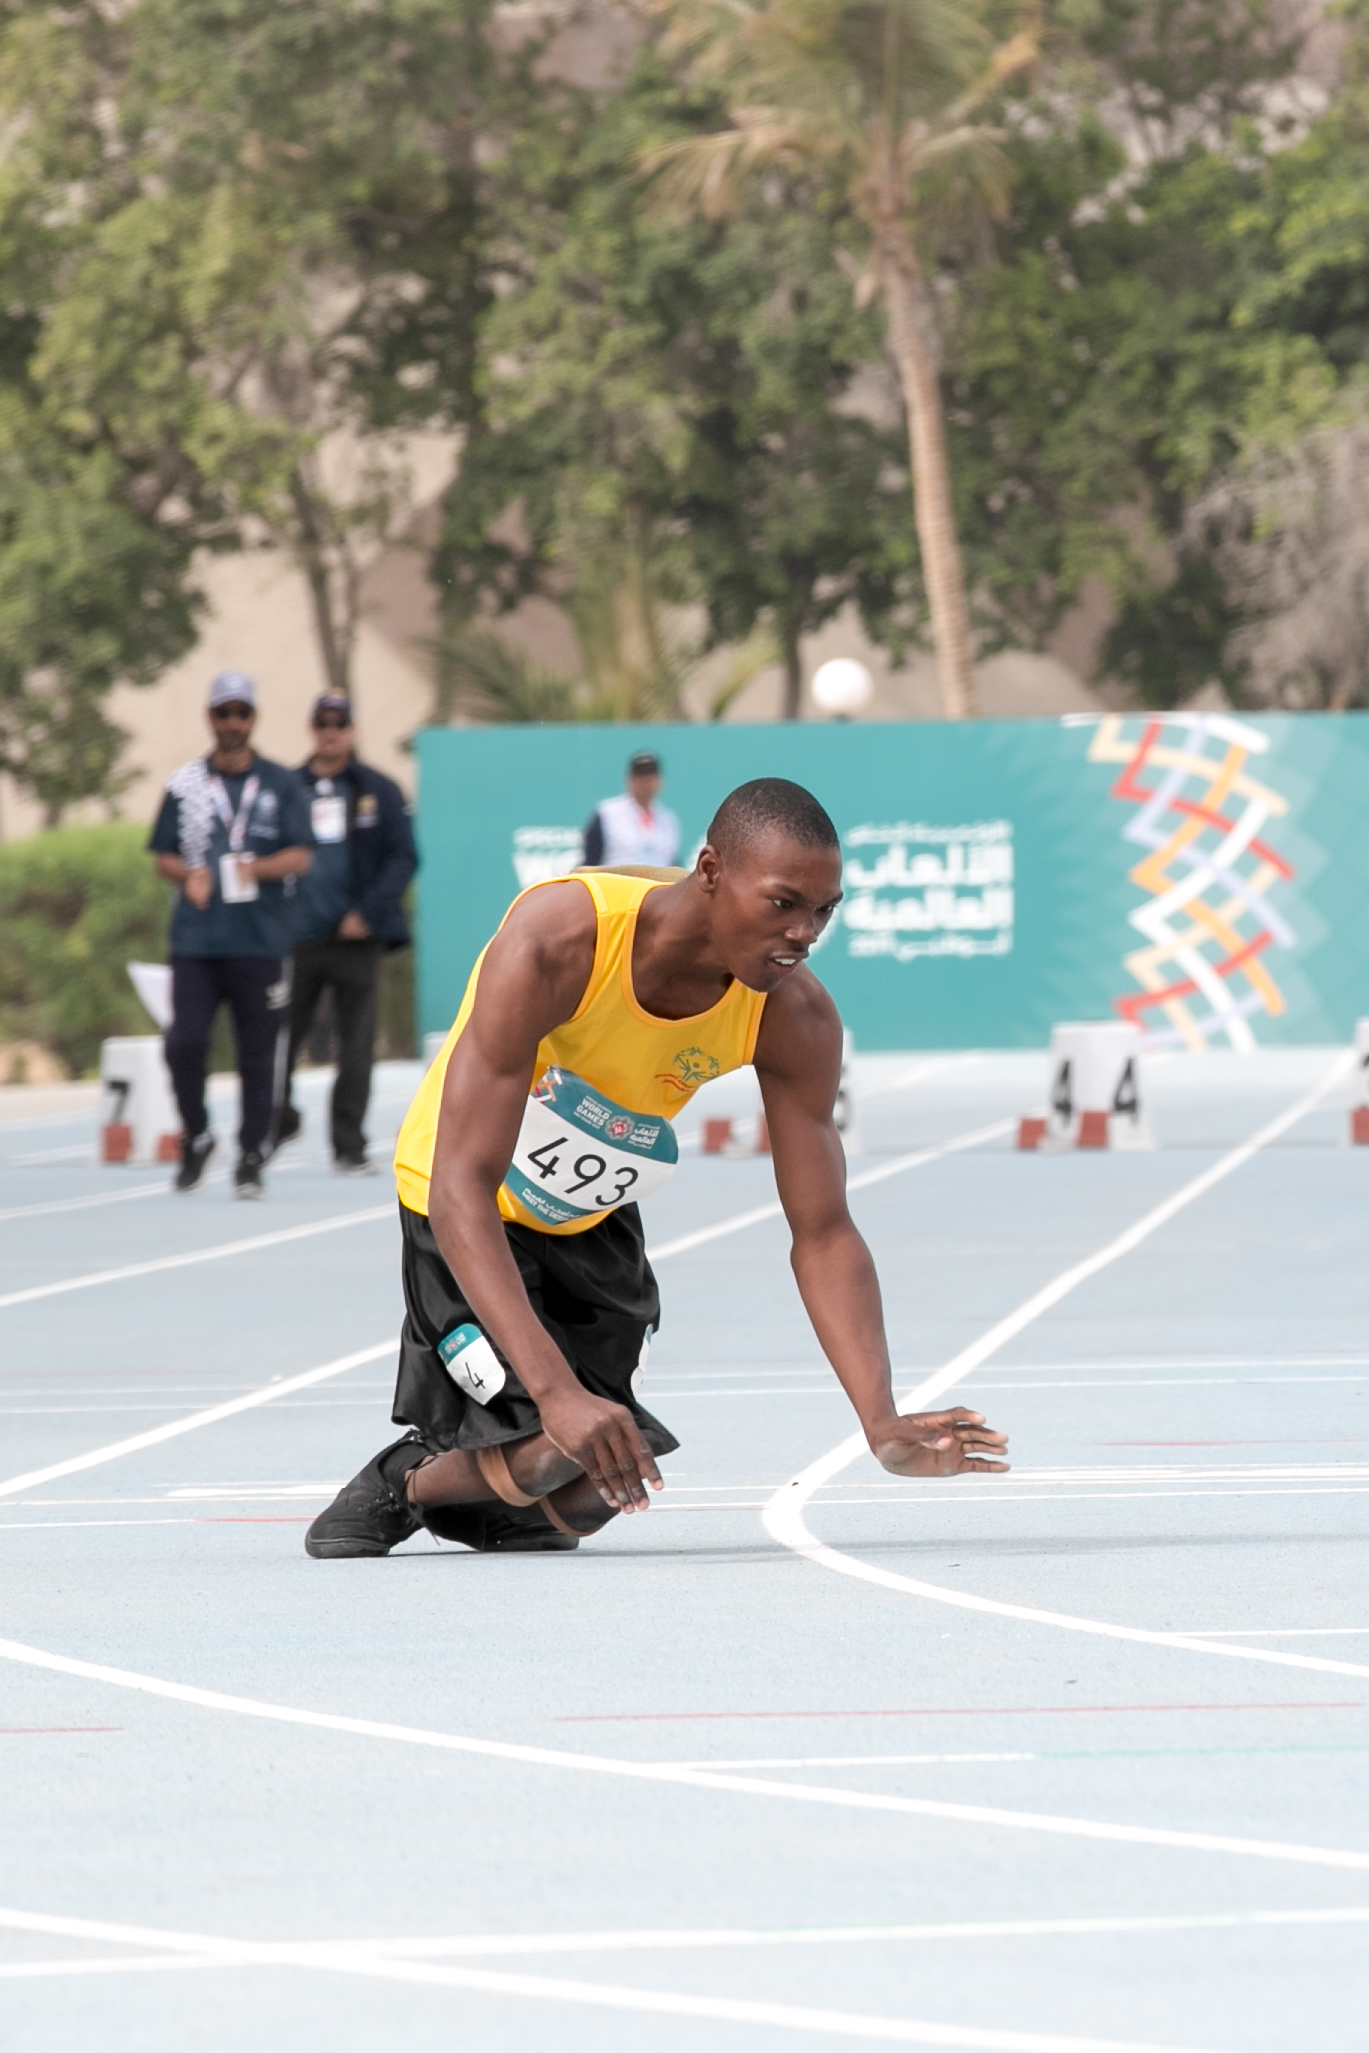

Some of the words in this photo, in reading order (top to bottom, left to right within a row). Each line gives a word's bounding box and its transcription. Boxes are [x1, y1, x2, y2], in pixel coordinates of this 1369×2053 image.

[107, 1078, 131, 1124] 7
[582, 1098, 610, 1120] WORLD
[1051, 1058, 1073, 1129] 4
[1115, 1056, 1140, 1127] 4
[576, 1105, 605, 1126] GAMES
[527, 1137, 639, 1206] 493
[537, 1204, 550, 1215] THE
[465, 1362, 486, 1389] 4
